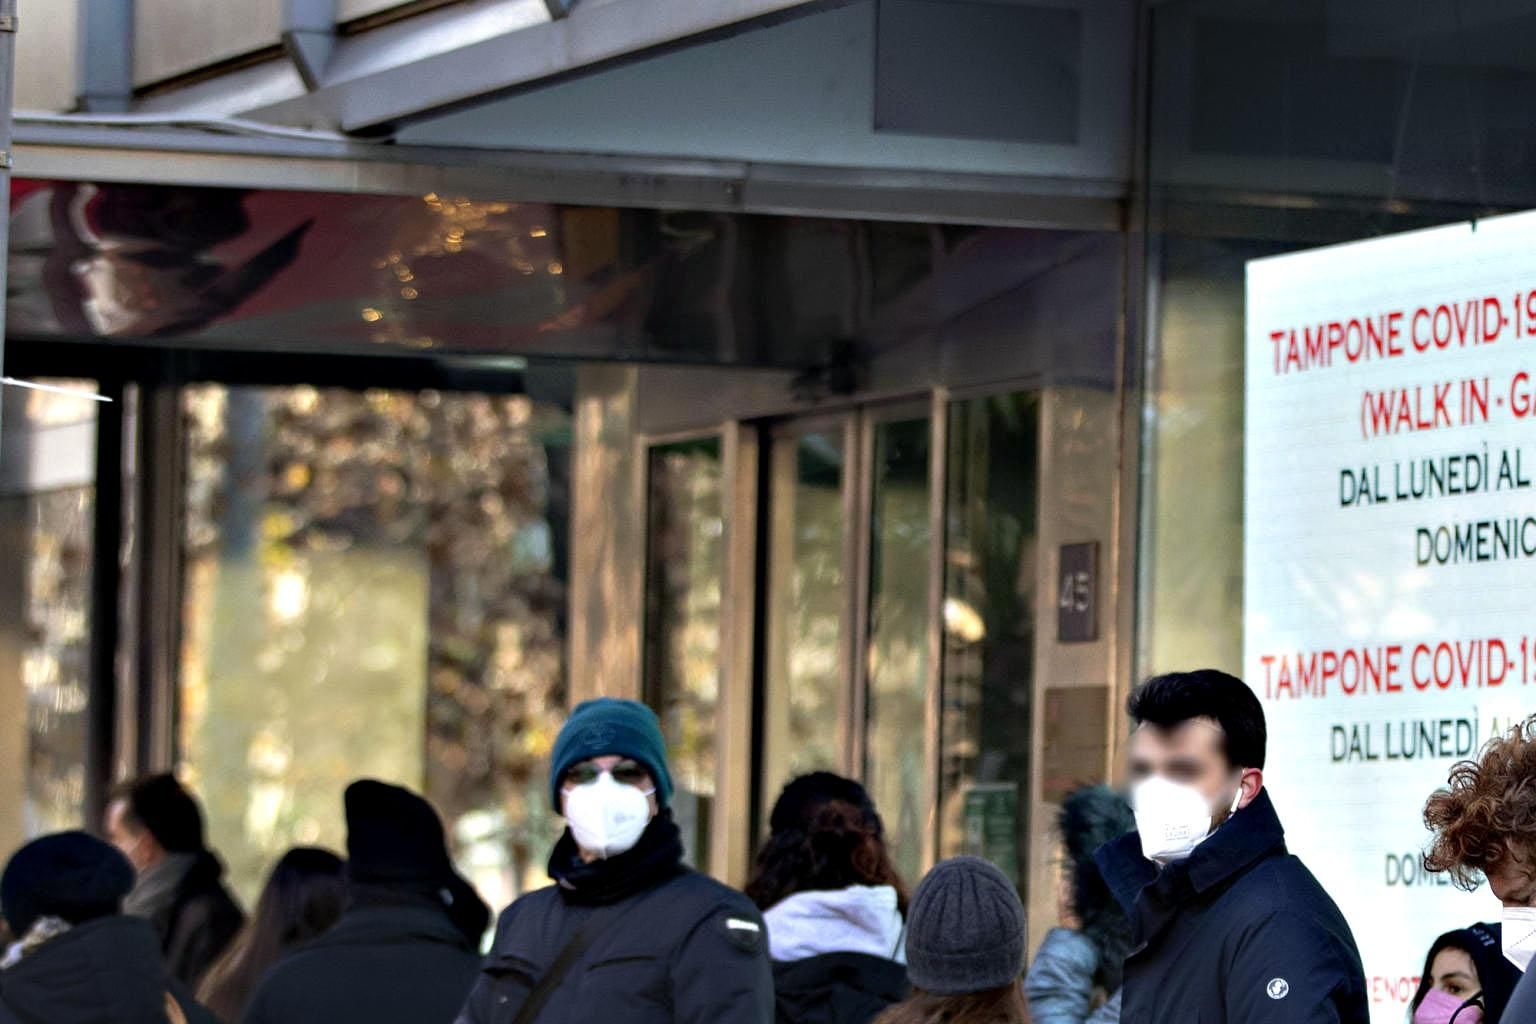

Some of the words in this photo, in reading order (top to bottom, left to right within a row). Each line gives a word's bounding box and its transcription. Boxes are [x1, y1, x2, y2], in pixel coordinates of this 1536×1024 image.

[1269, 312, 1404, 375] TAMPONE
[1360, 381, 1452, 440] (WALK
[1460, 377, 1489, 426] IN
[1339, 466, 1389, 508] DAL
[1395, 441, 1489, 503] LUNEDÌ
[1496, 448, 1532, 491] AL
[1060, 572, 1089, 612] 45
[1260, 643, 1404, 699] TAMPONE
[1330, 724, 1380, 763] DAL
[1385, 704, 1477, 761] LUNEDÌ
